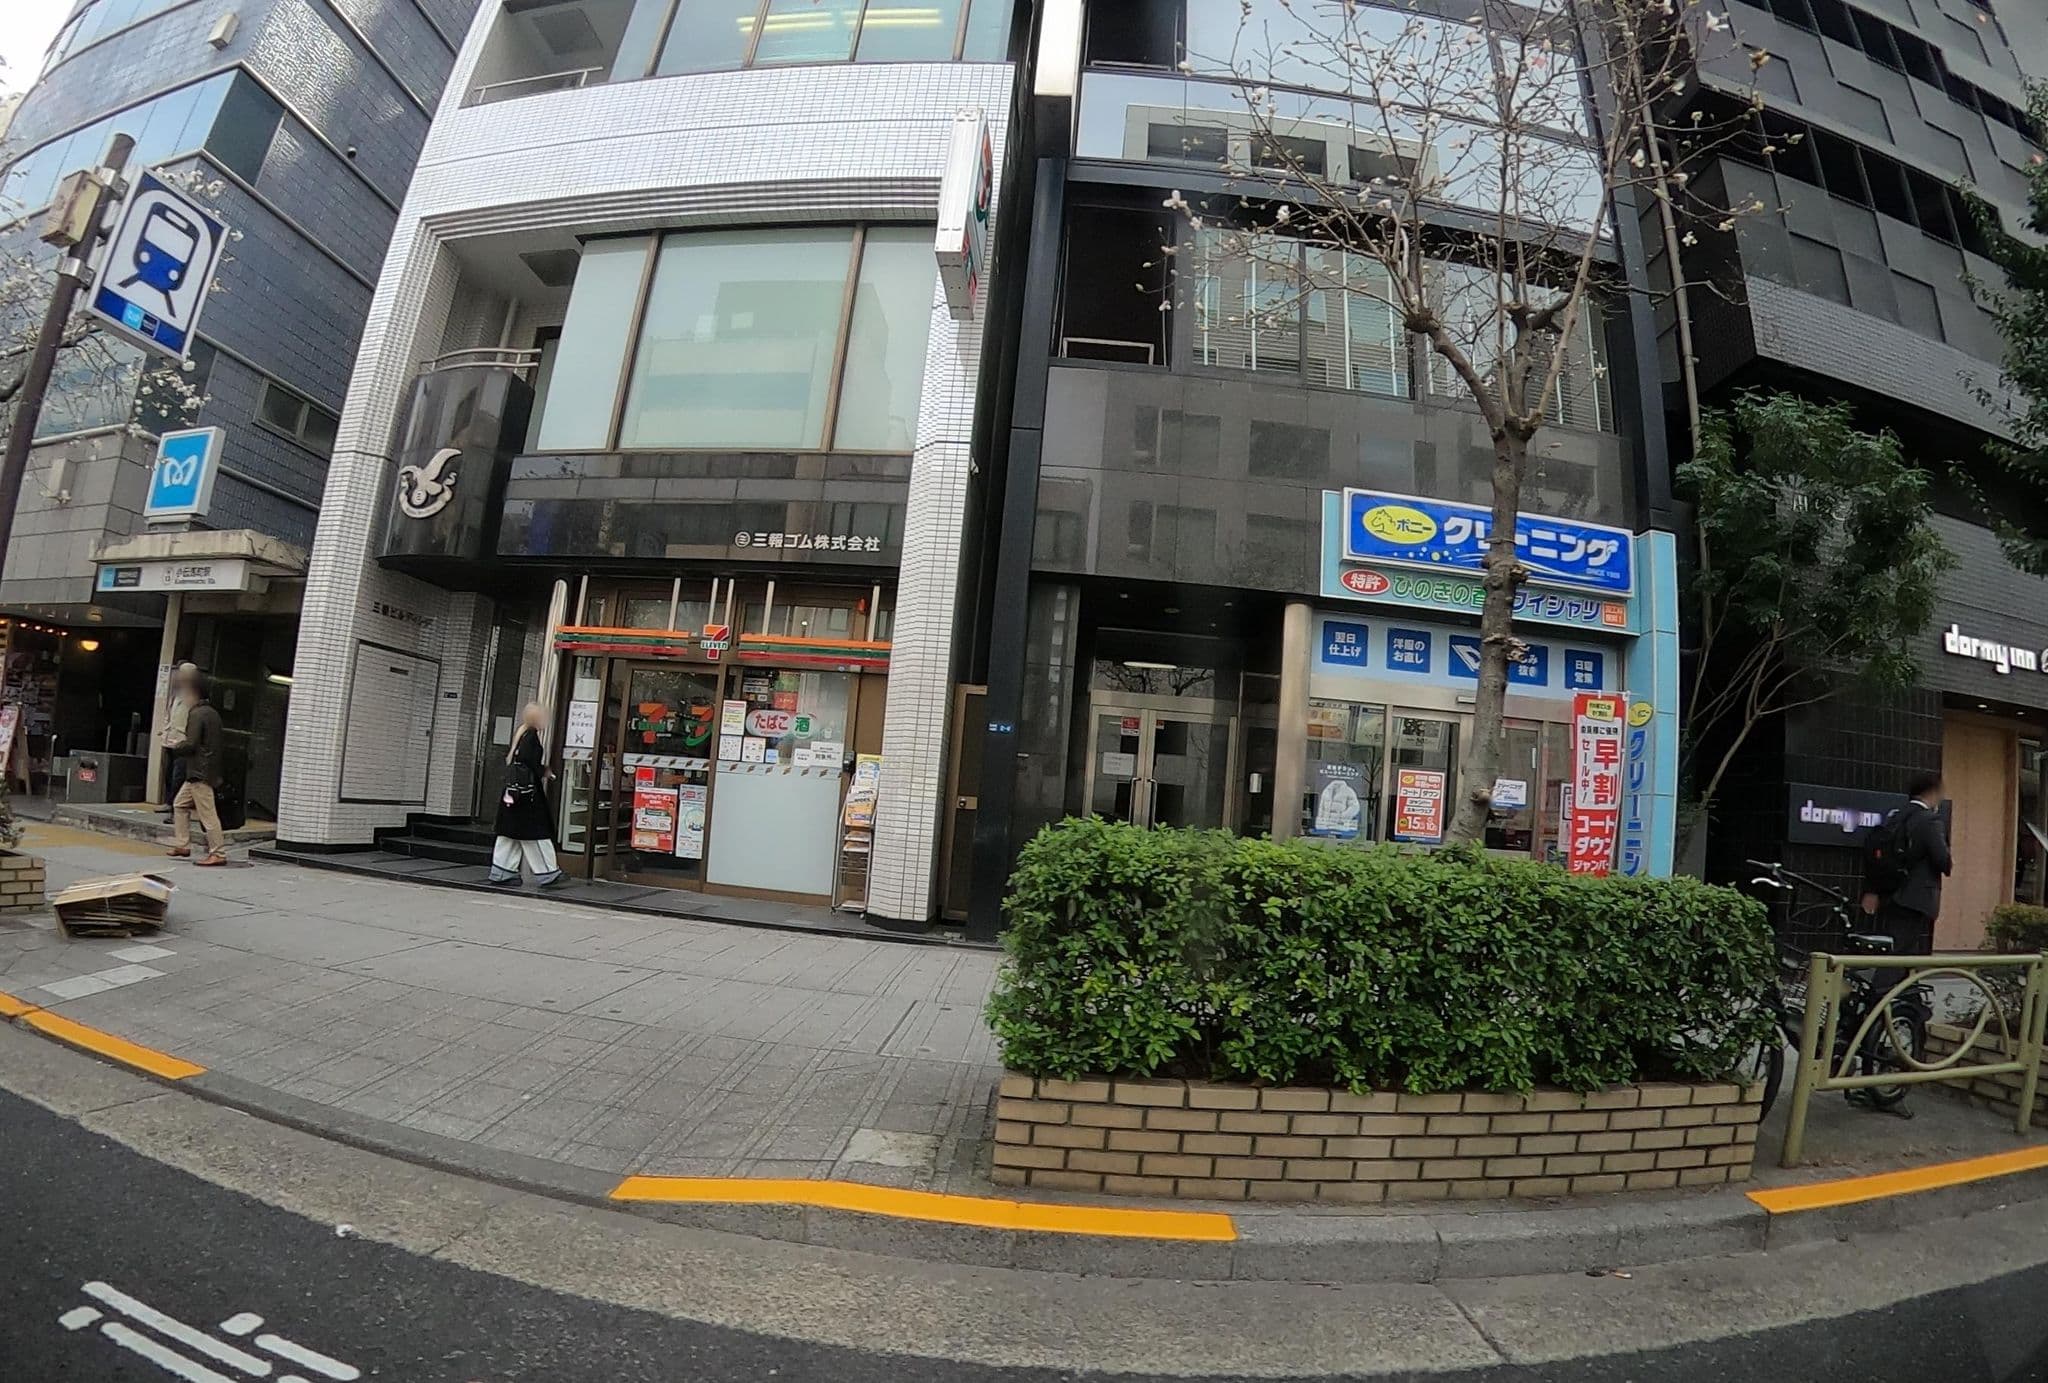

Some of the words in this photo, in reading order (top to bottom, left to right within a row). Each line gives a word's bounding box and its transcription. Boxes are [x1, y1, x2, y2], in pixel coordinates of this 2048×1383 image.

[1396, 519, 1432, 532] ポニー
[752, 532, 880, 551] 三報ゴム株式会社
[1350, 573, 1382, 590] 特許
[703, 624, 729, 659] 7
[1329, 643, 1361, 657] 仕上げ
[1393, 637, 1425, 651] 洋服の
[1393, 650, 1424, 664] お直し
[754, 713, 788, 731] たばこ
[795, 716, 810, 733] 酒
[1593, 739, 1619, 805] 早割
[1576, 815, 1615, 834] コート
